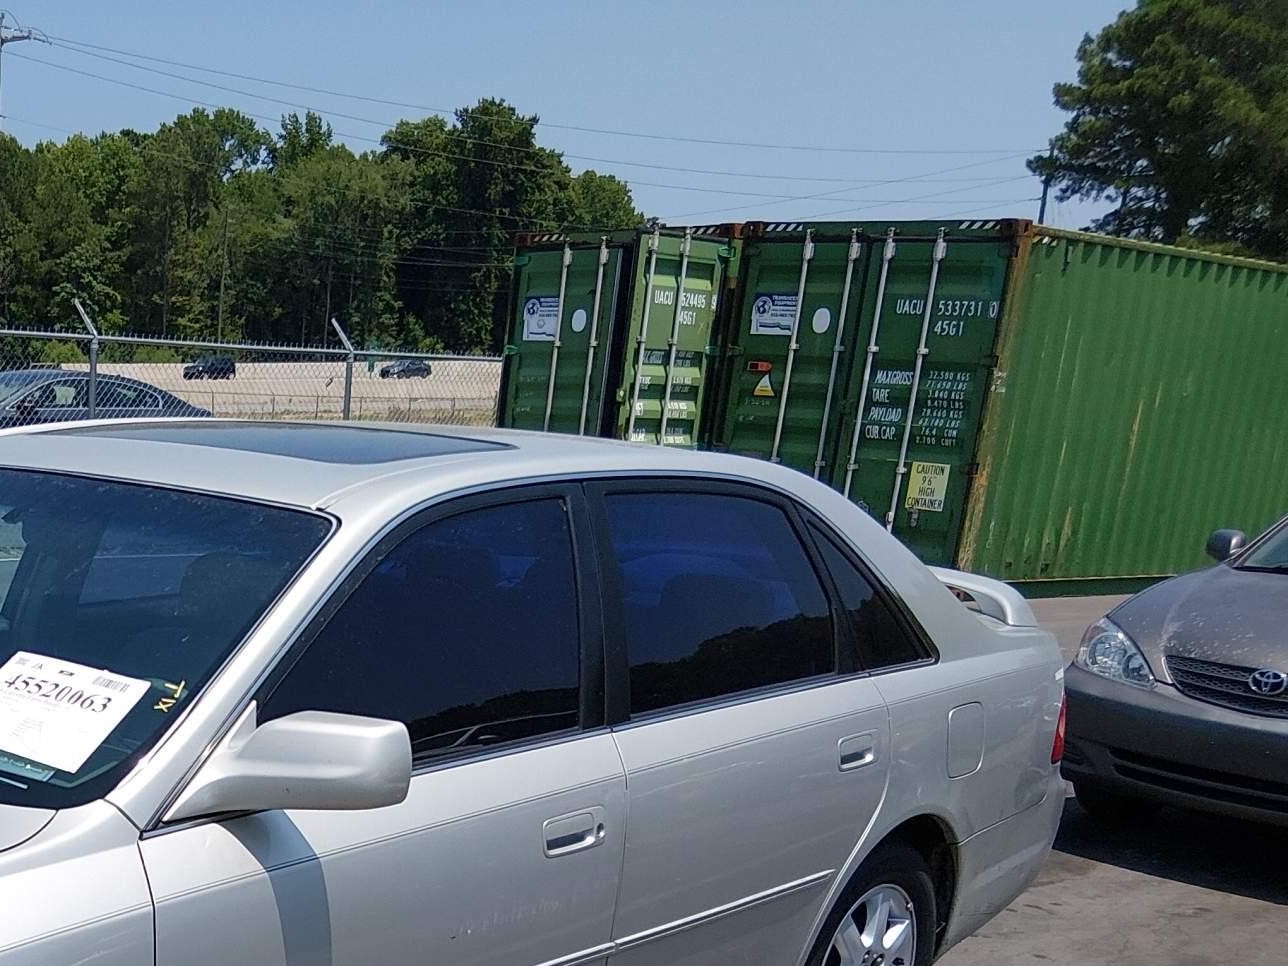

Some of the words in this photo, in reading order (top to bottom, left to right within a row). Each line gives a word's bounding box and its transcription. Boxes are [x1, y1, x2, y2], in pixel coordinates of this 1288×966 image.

[654, 289, 673, 305] UACU
[896, 299, 924, 315] UACU
[937, 300, 984, 317] 533731
[988, 301, 999, 319] 0
[679, 310, 696, 326] 45G1
[934, 320, 964, 337] 45G1
[956, 372, 970, 381] KGS
[953, 381, 968, 391] LBS
[872, 388, 891, 403] TARE
[951, 391, 964, 400] KGS
[950, 401, 964, 409] LBS
[868, 406, 902, 422] PAYLOAD
[949, 409, 963, 419] KGS
[946, 419, 961, 429] LBS
[916, 464, 946, 476] CAUTION
[918, 486, 935, 498] HIGH
[906, 496, 943, 510] CONTAINER
[4, 673, 112, 713] 45520063
